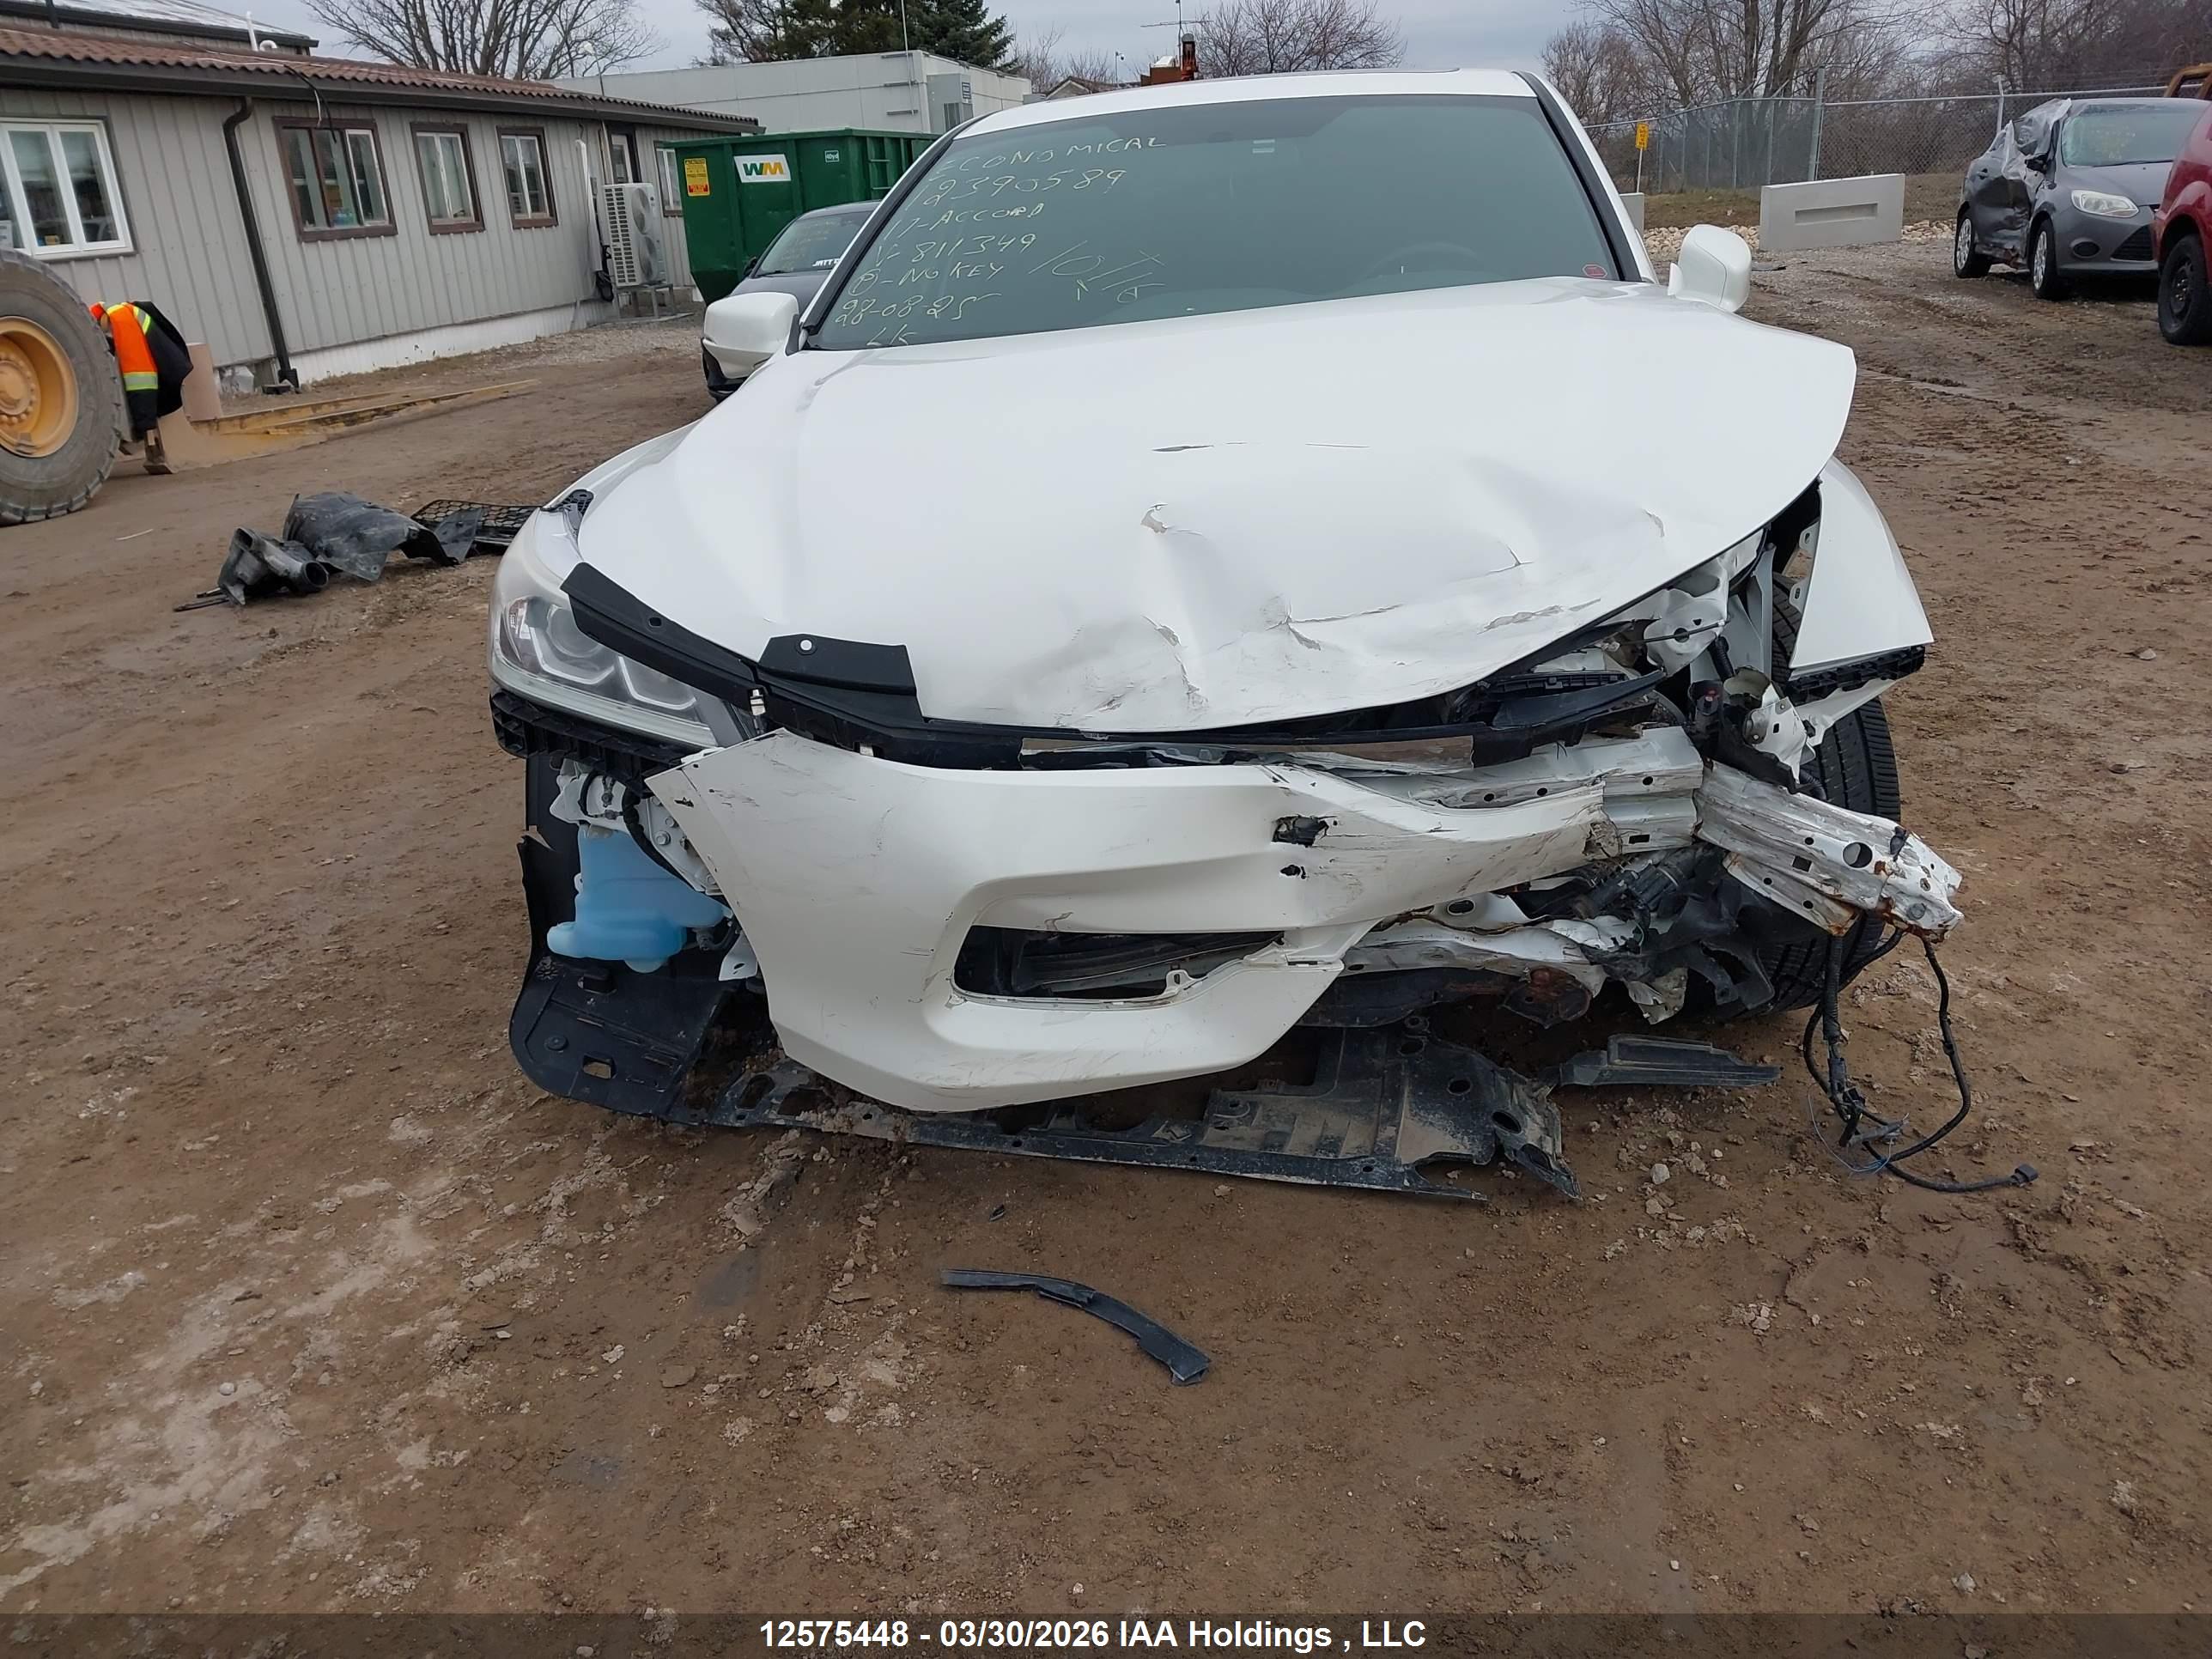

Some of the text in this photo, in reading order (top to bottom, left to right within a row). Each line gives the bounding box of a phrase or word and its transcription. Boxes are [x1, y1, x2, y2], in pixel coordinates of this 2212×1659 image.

[743, 162, 784, 176] WM
[907, 168, 1127, 211] 12390589
[949, 261, 1004, 280] KEY
